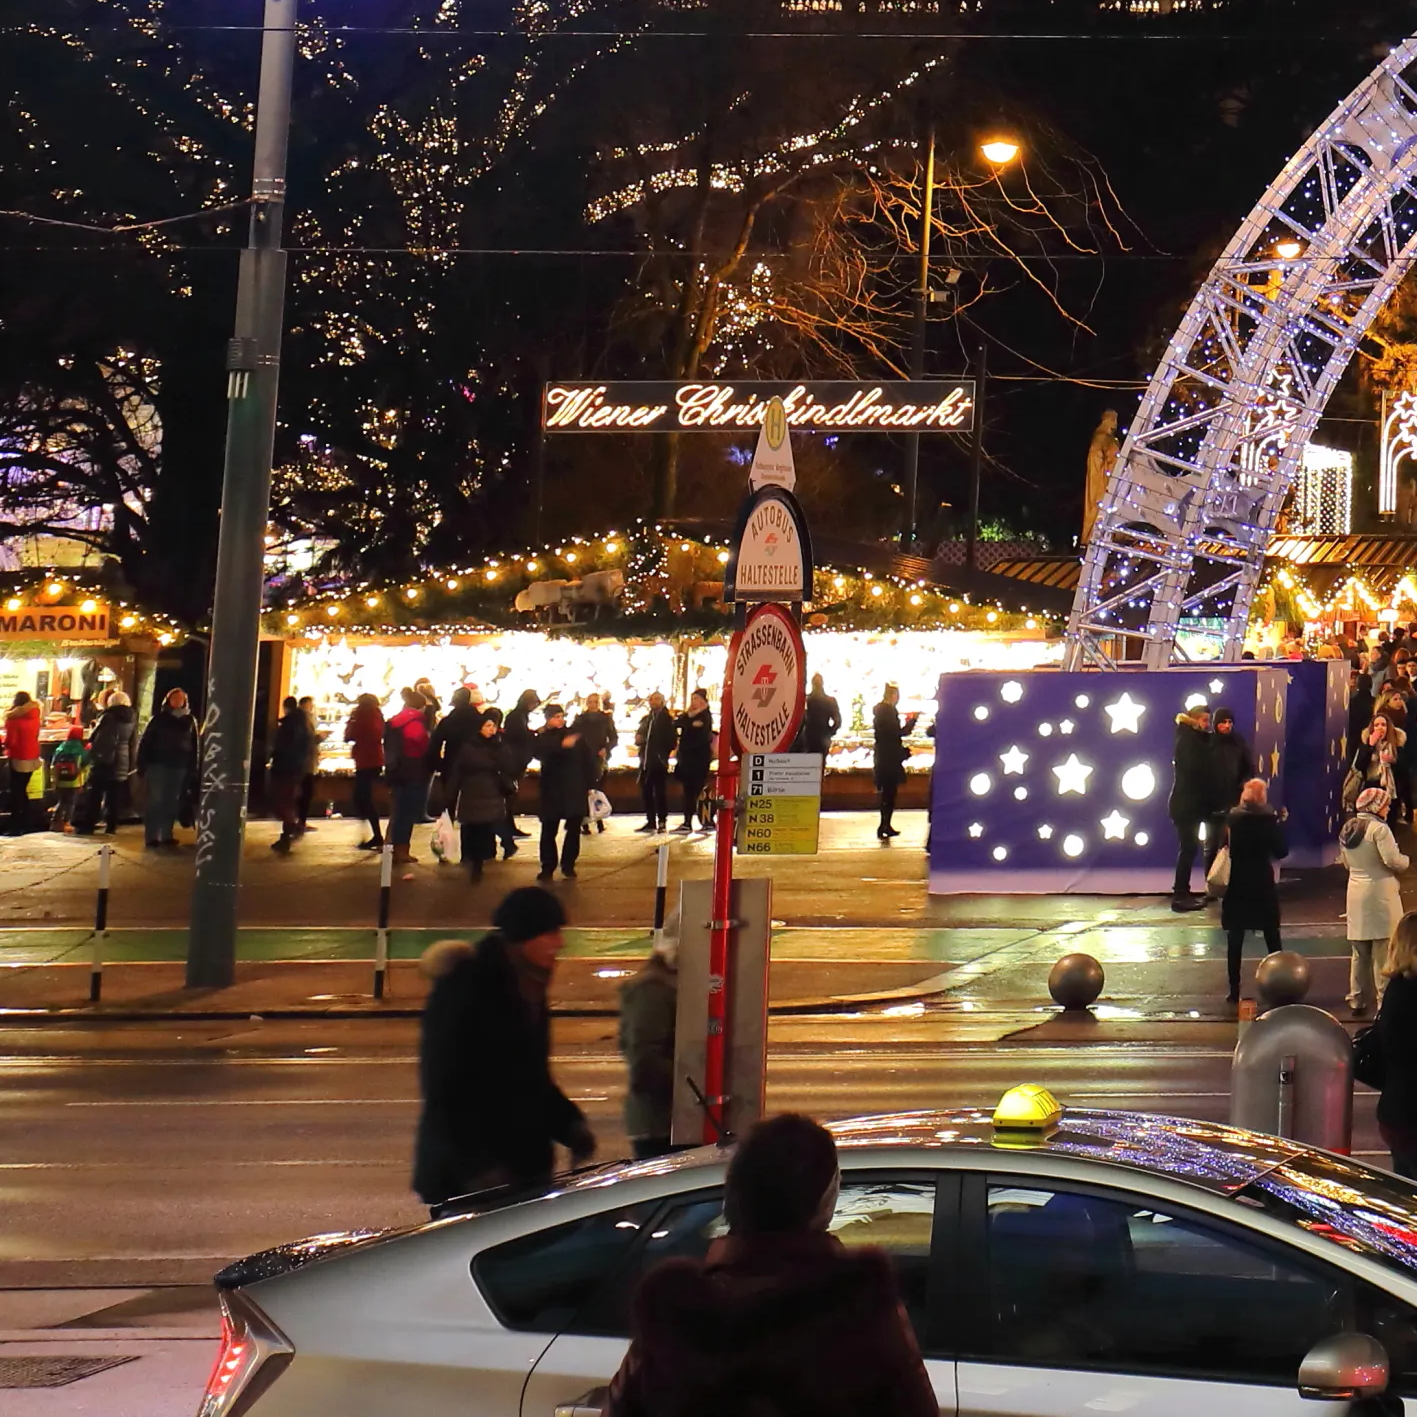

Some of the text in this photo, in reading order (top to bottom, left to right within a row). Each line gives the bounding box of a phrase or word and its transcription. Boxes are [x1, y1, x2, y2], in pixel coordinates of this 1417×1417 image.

[547, 384, 668, 428] Wiener
[752, 505, 794, 543] AUTOBUS
[740, 565, 798, 585] HALTESTELLE
[0, 614, 106, 632] MARONI
[736, 623, 796, 678] STRASSENBAHN
[736, 702, 790, 747] HALTESTELLE
[752, 785, 763, 794] 71
[749, 799, 772, 809] N25
[747, 828, 772, 838] N60
[747, 842, 771, 852] N66
